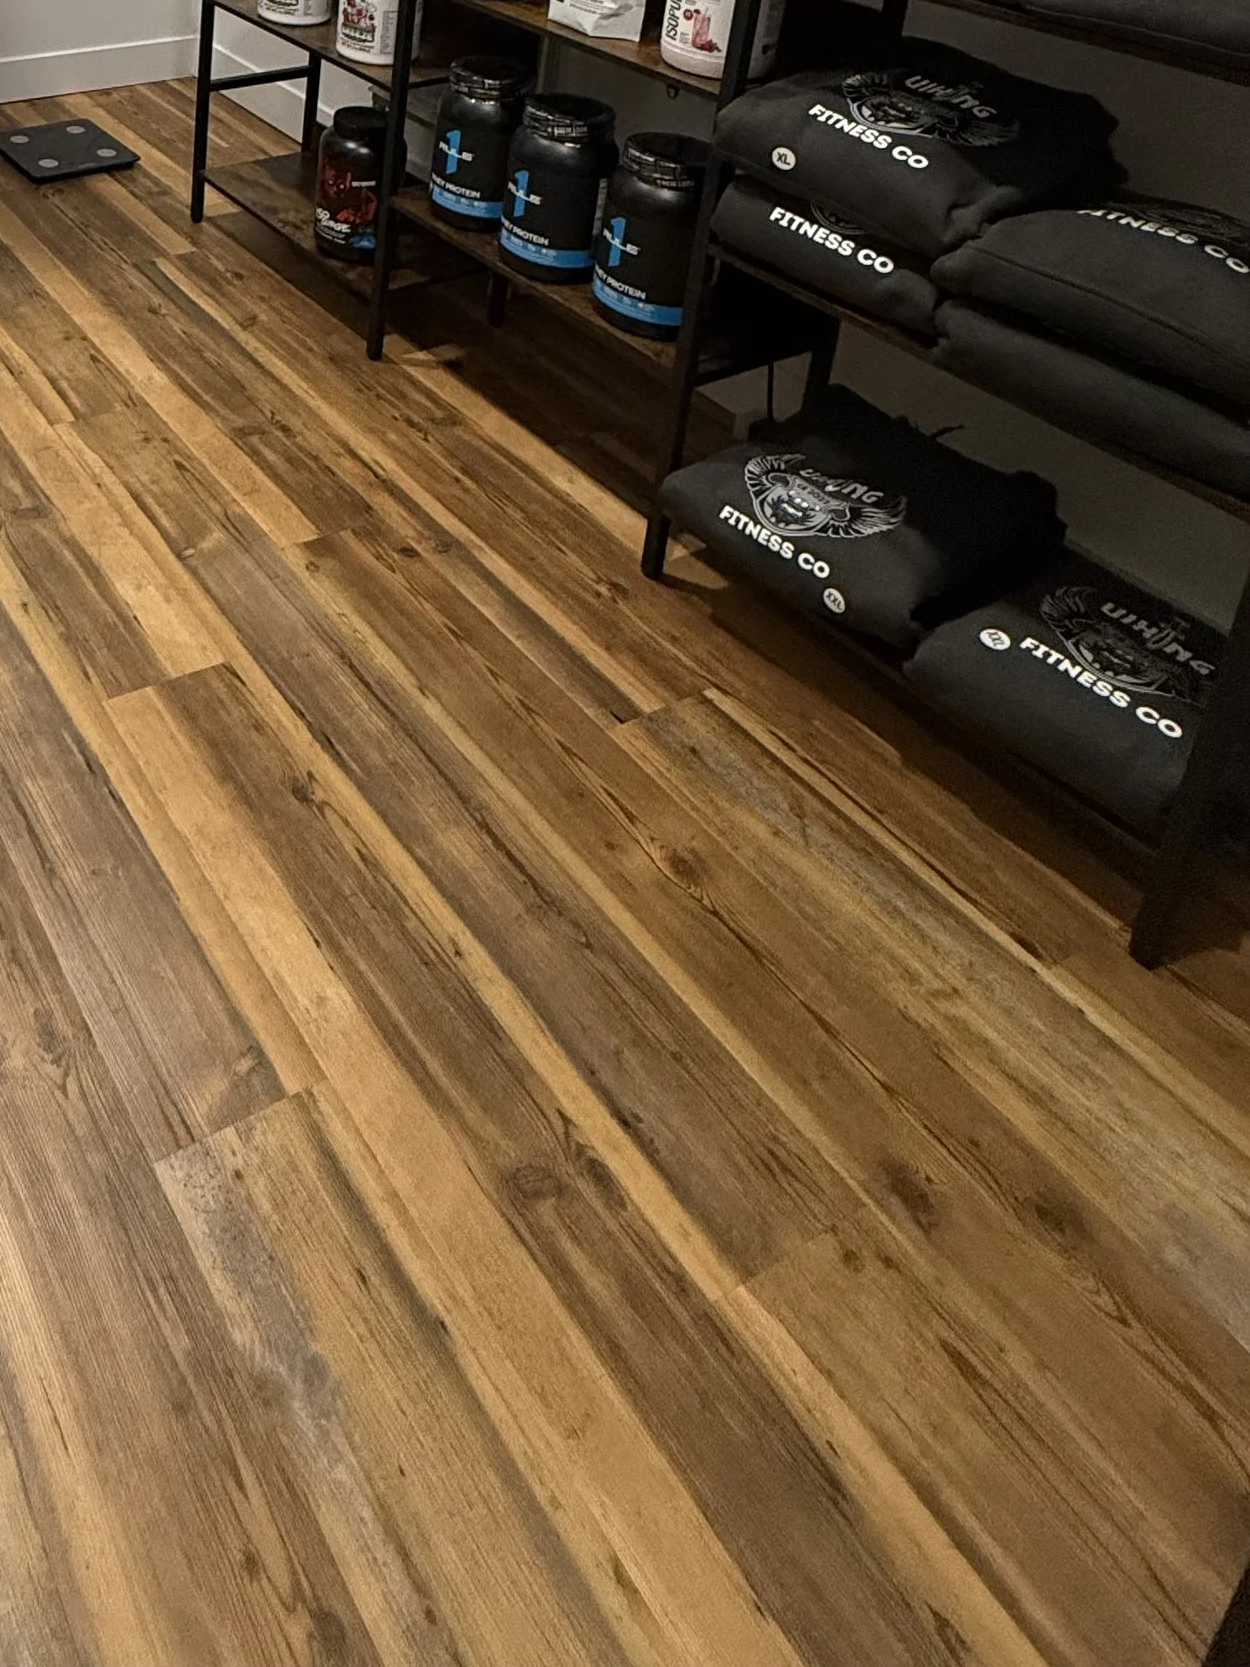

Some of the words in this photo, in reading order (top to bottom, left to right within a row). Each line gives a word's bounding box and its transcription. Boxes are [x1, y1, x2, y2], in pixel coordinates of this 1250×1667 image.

[808, 104, 892, 149] FITNESS
[892, 146, 929, 169] CO
[775, 152, 792, 166] XL
[445, 181, 481, 199] PROTEIN
[512, 224, 549, 246] PROTEIN
[769, 206, 856, 256] FITNESS
[857, 248, 894, 273] CO
[1204, 245, 1250, 273] CO
[607, 275, 646, 300] PROTEIN
[719, 505, 795, 559] FITNESS
[797, 552, 830, 578] CO
[825, 591, 844, 611] XXL
[1019, 637, 1131, 708] FITNESS
[1135, 706, 1183, 738] CO
